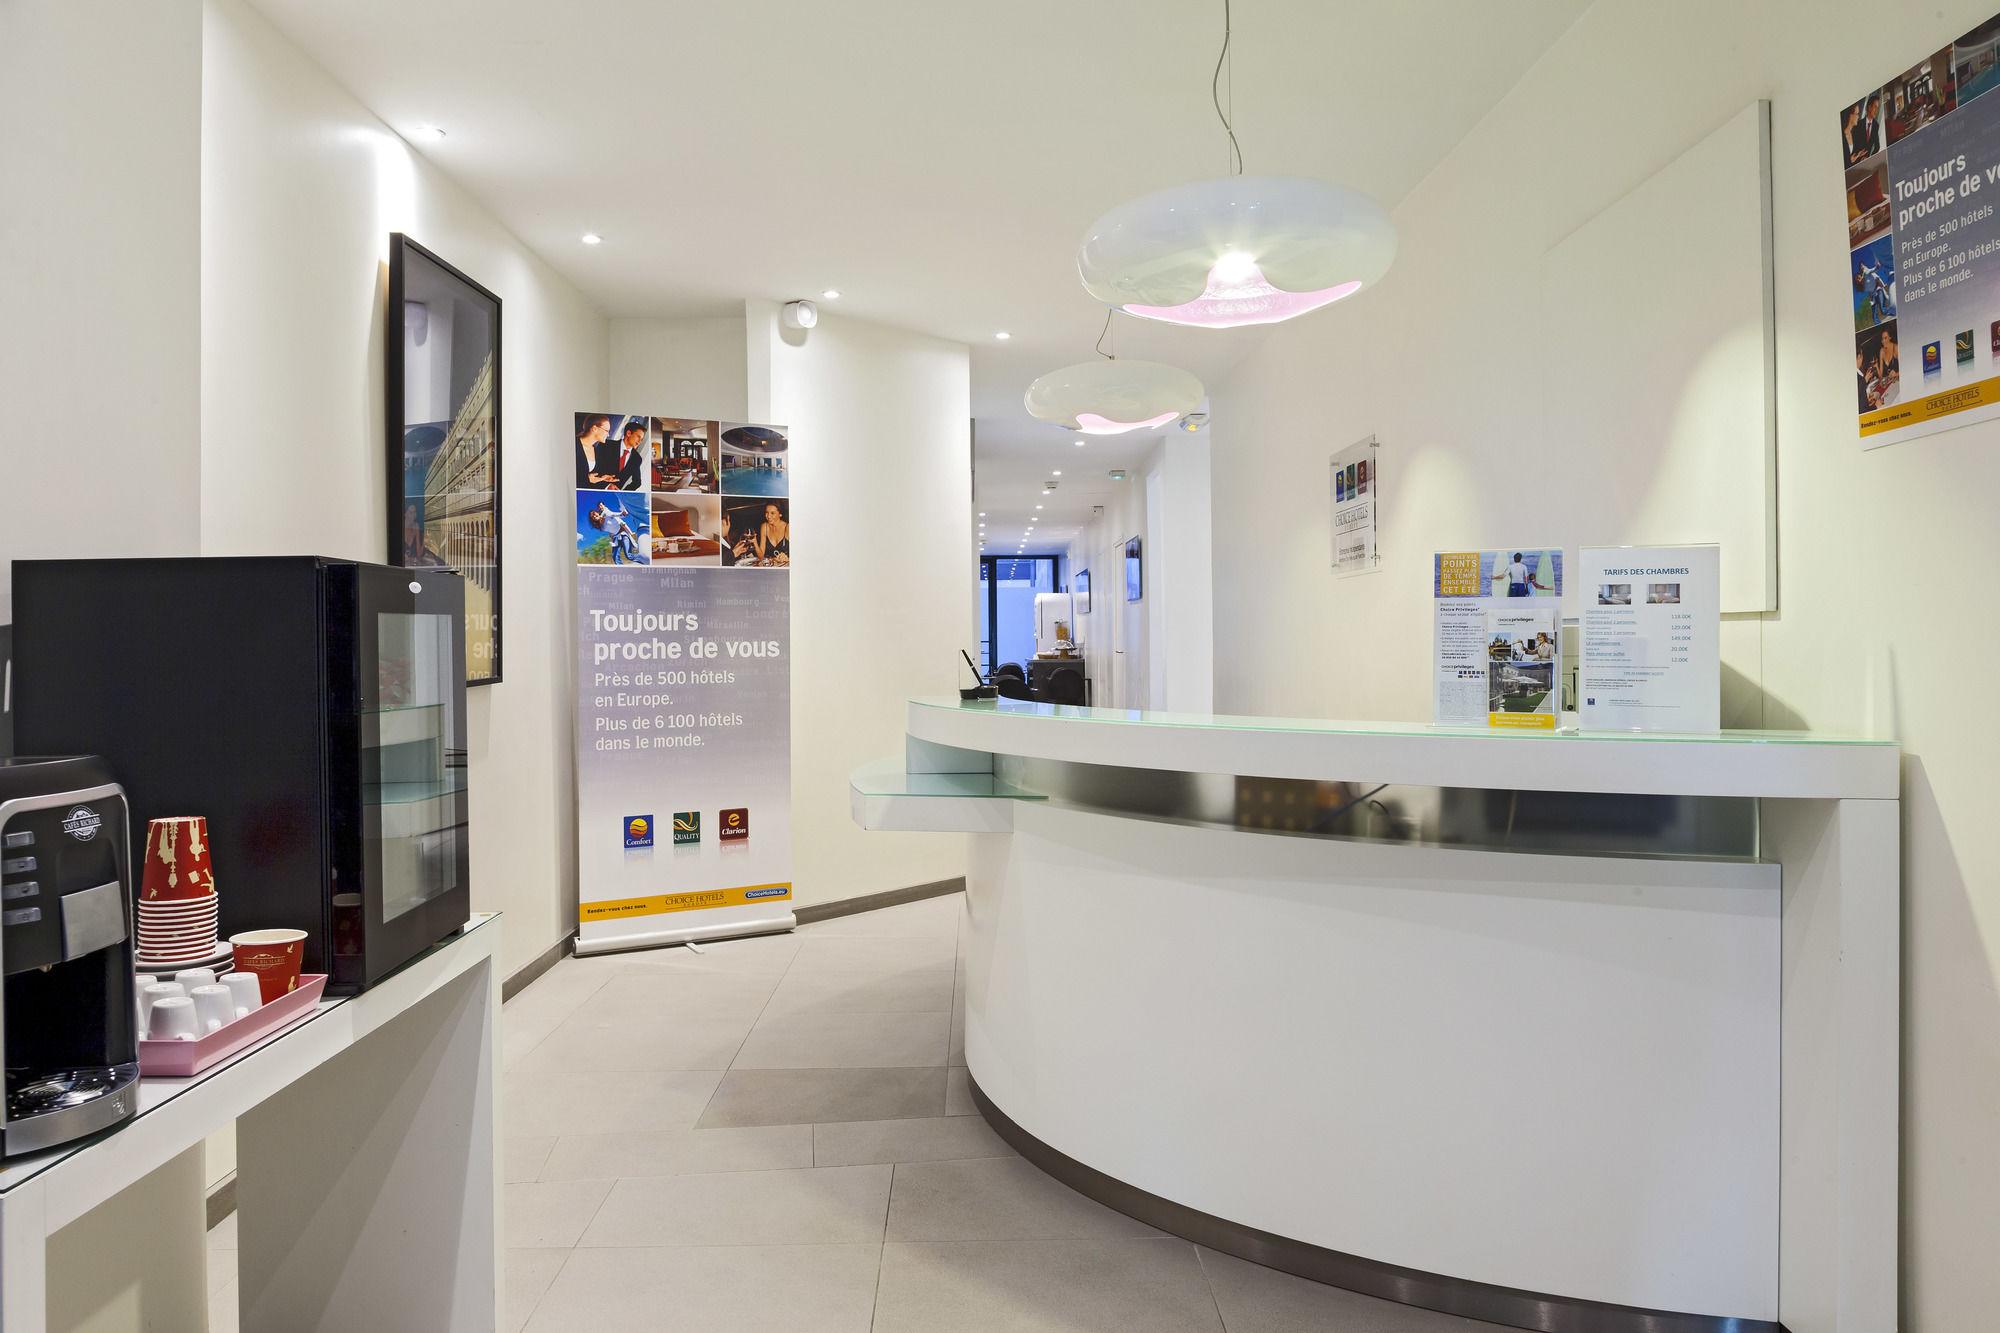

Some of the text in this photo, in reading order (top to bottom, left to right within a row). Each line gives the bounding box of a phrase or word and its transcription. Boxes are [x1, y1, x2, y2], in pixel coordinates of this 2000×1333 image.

[1895, 154, 1966, 202] Toujours
[1899, 187, 1955, 231] proche
[1960, 174, 1981, 198] de
[1901, 205, 1993, 254] Près de 500 hôtels
[1902, 243, 1951, 270] en Europe.
[1903, 271, 1923, 287] Plus
[1925, 264, 1937, 278] de
[1939, 259, 1946, 272] 6
[1948, 251, 1966, 270] 100
[1904, 268, 1974, 303] dans le monde.
[1952, 389, 1980, 402] HOTELS
[1443, 560, 1477, 568] POINTS
[1443, 586, 1459, 594] CET
[590, 608, 698, 634] Toujours
[594, 637, 780, 665] proche de vous
[595, 670, 735, 686] Près de 500 hôtels
[595, 695, 613, 707] en
[617, 693, 674, 708] Europe.
[596, 712, 743, 731] Plus de 6 100 hôtels
[596, 733, 705, 751] dans le monde.
[674, 833, 700, 841] QUALITY
[722, 827, 746, 836] Clarion
[626, 838, 652, 846] Comfort
[665, 892, 725, 905] CHOICE HOTELS
